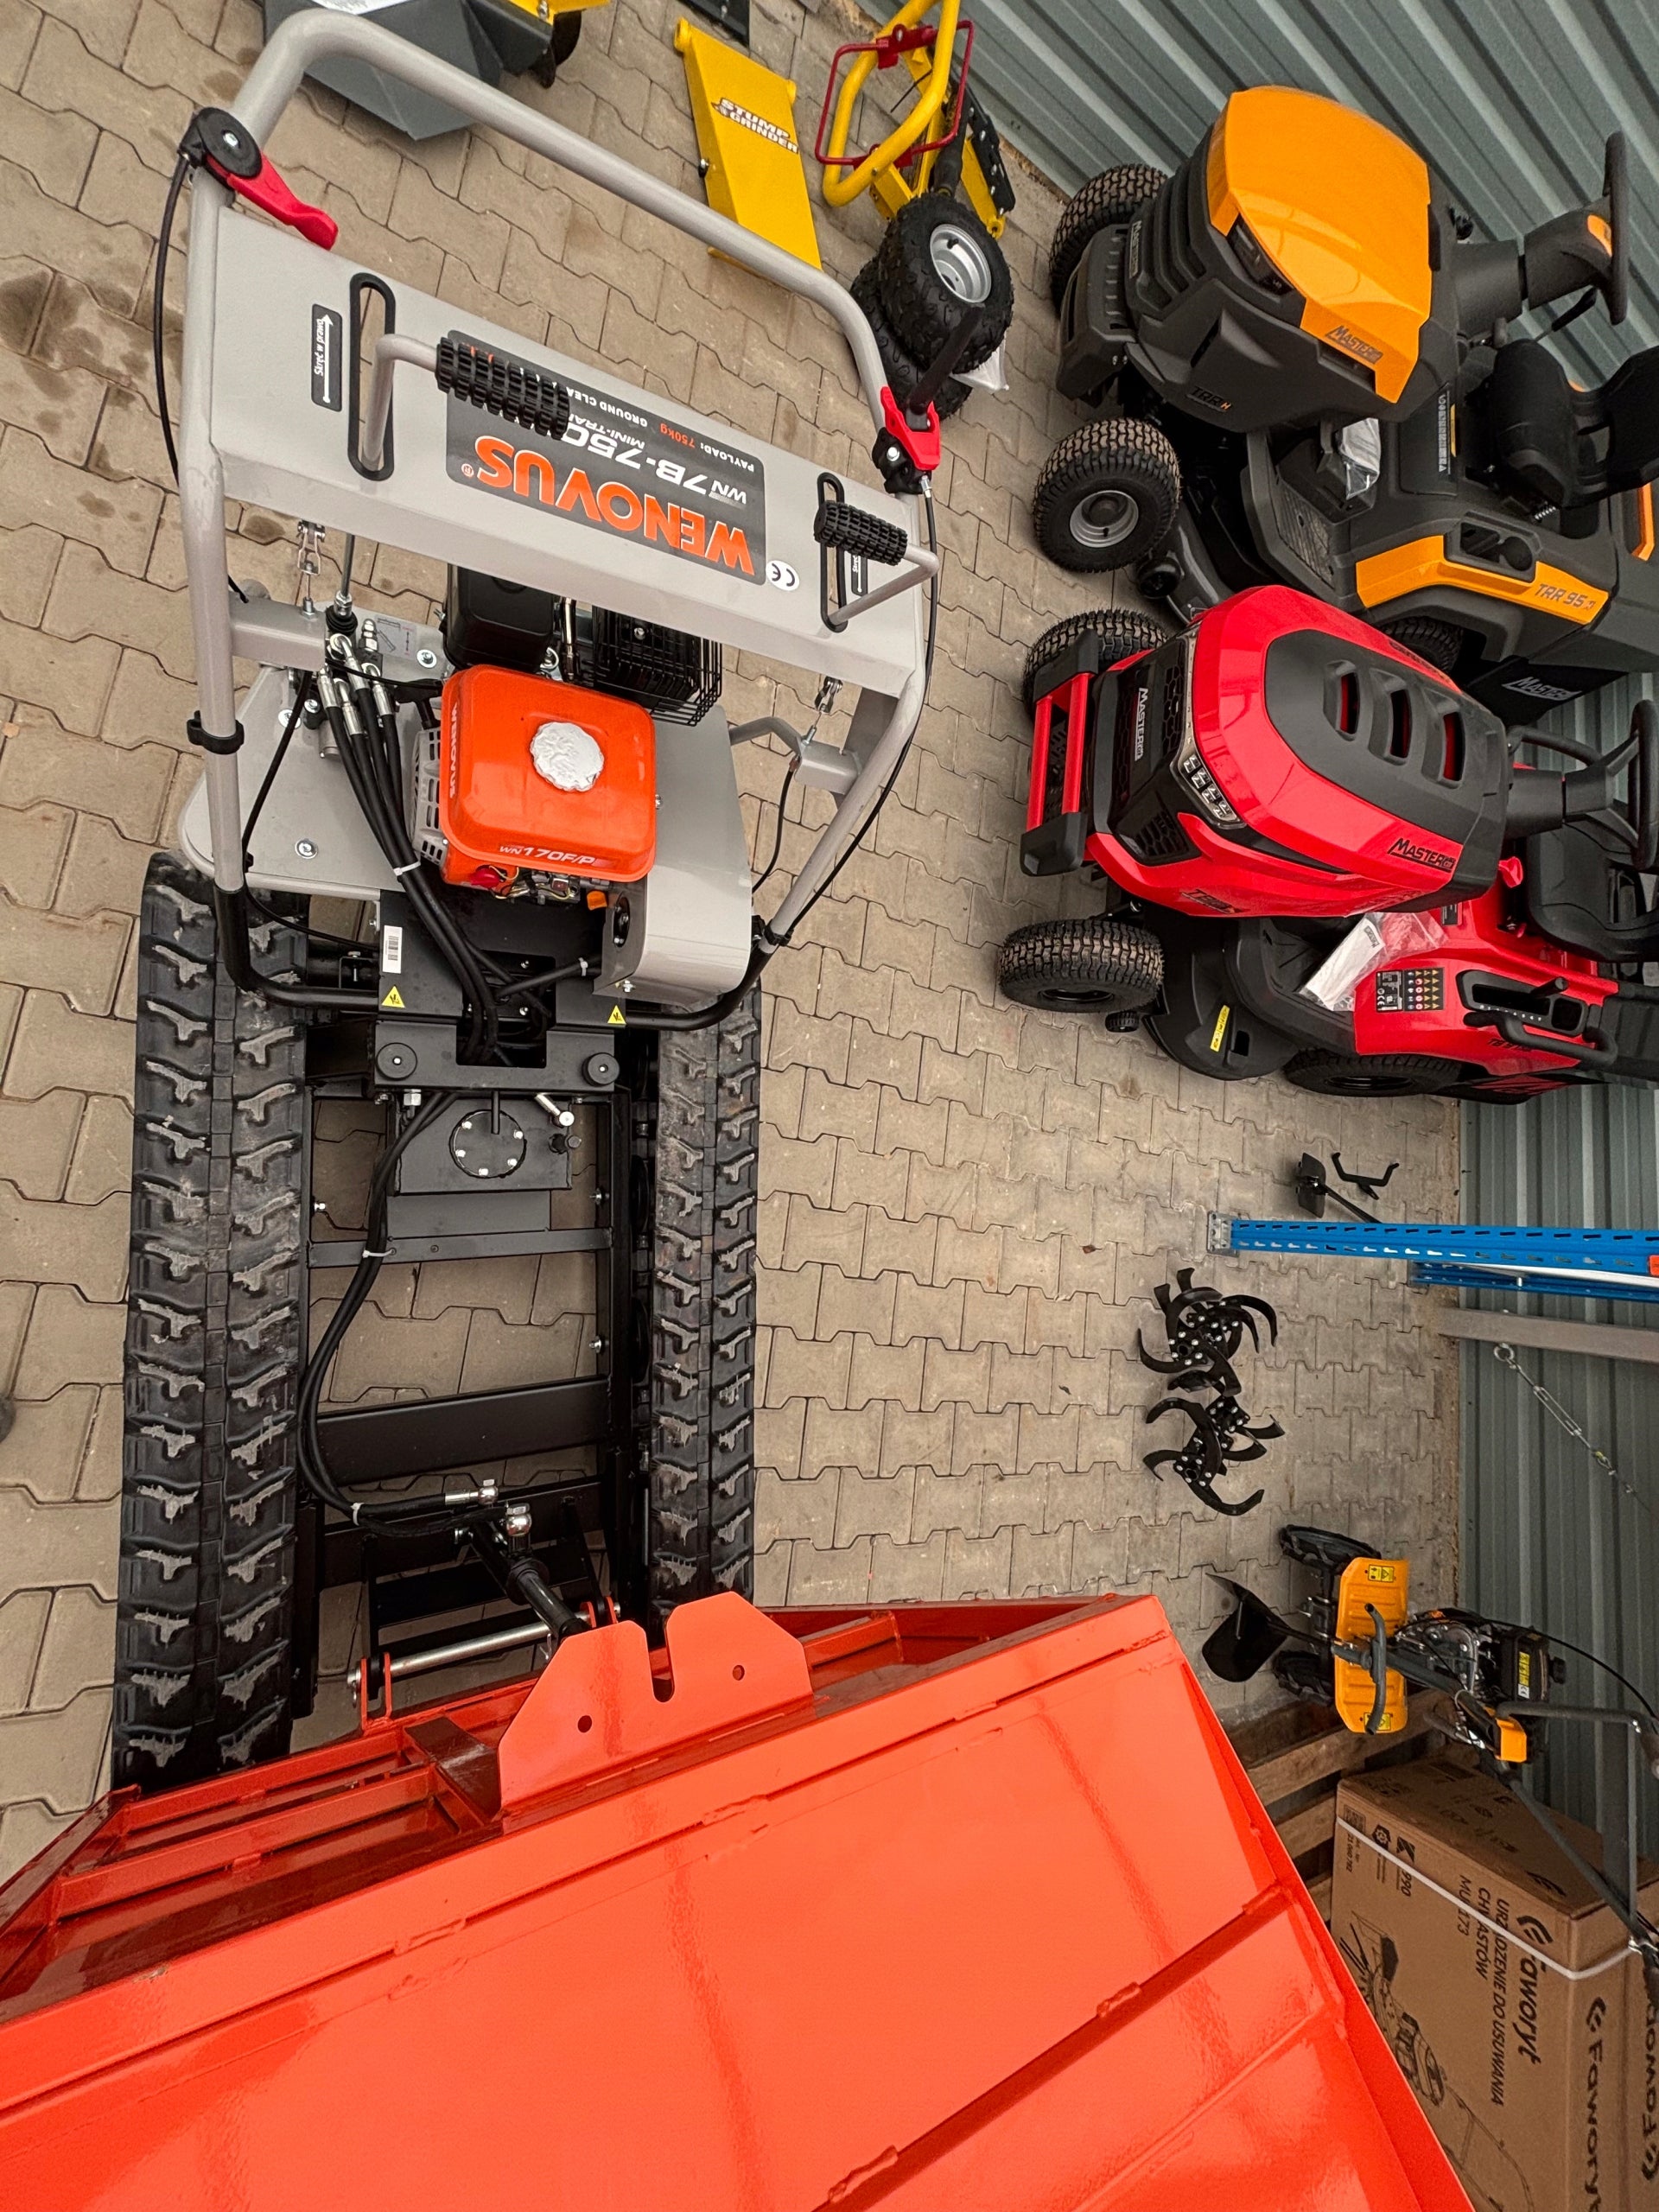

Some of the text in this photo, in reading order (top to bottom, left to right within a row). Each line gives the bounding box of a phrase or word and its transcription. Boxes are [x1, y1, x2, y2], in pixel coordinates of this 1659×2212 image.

[720, 97, 791, 138] STUMP
[728, 111, 798, 154] GRINDER
[566, 386, 755, 473] PAYLOAD: 750kg GROUND CLEA
[474, 435, 756, 575] WENOVUS
[710, 478, 747, 505] WN
[1563, 588, 1588, 608] 95
[449, 702, 459, 799] WENOVUS
[499, 846, 596, 865] WN 170F/P
[1492, 1992, 1506, 2019] DO
[1491, 2019, 1505, 2107] USUWANIA
